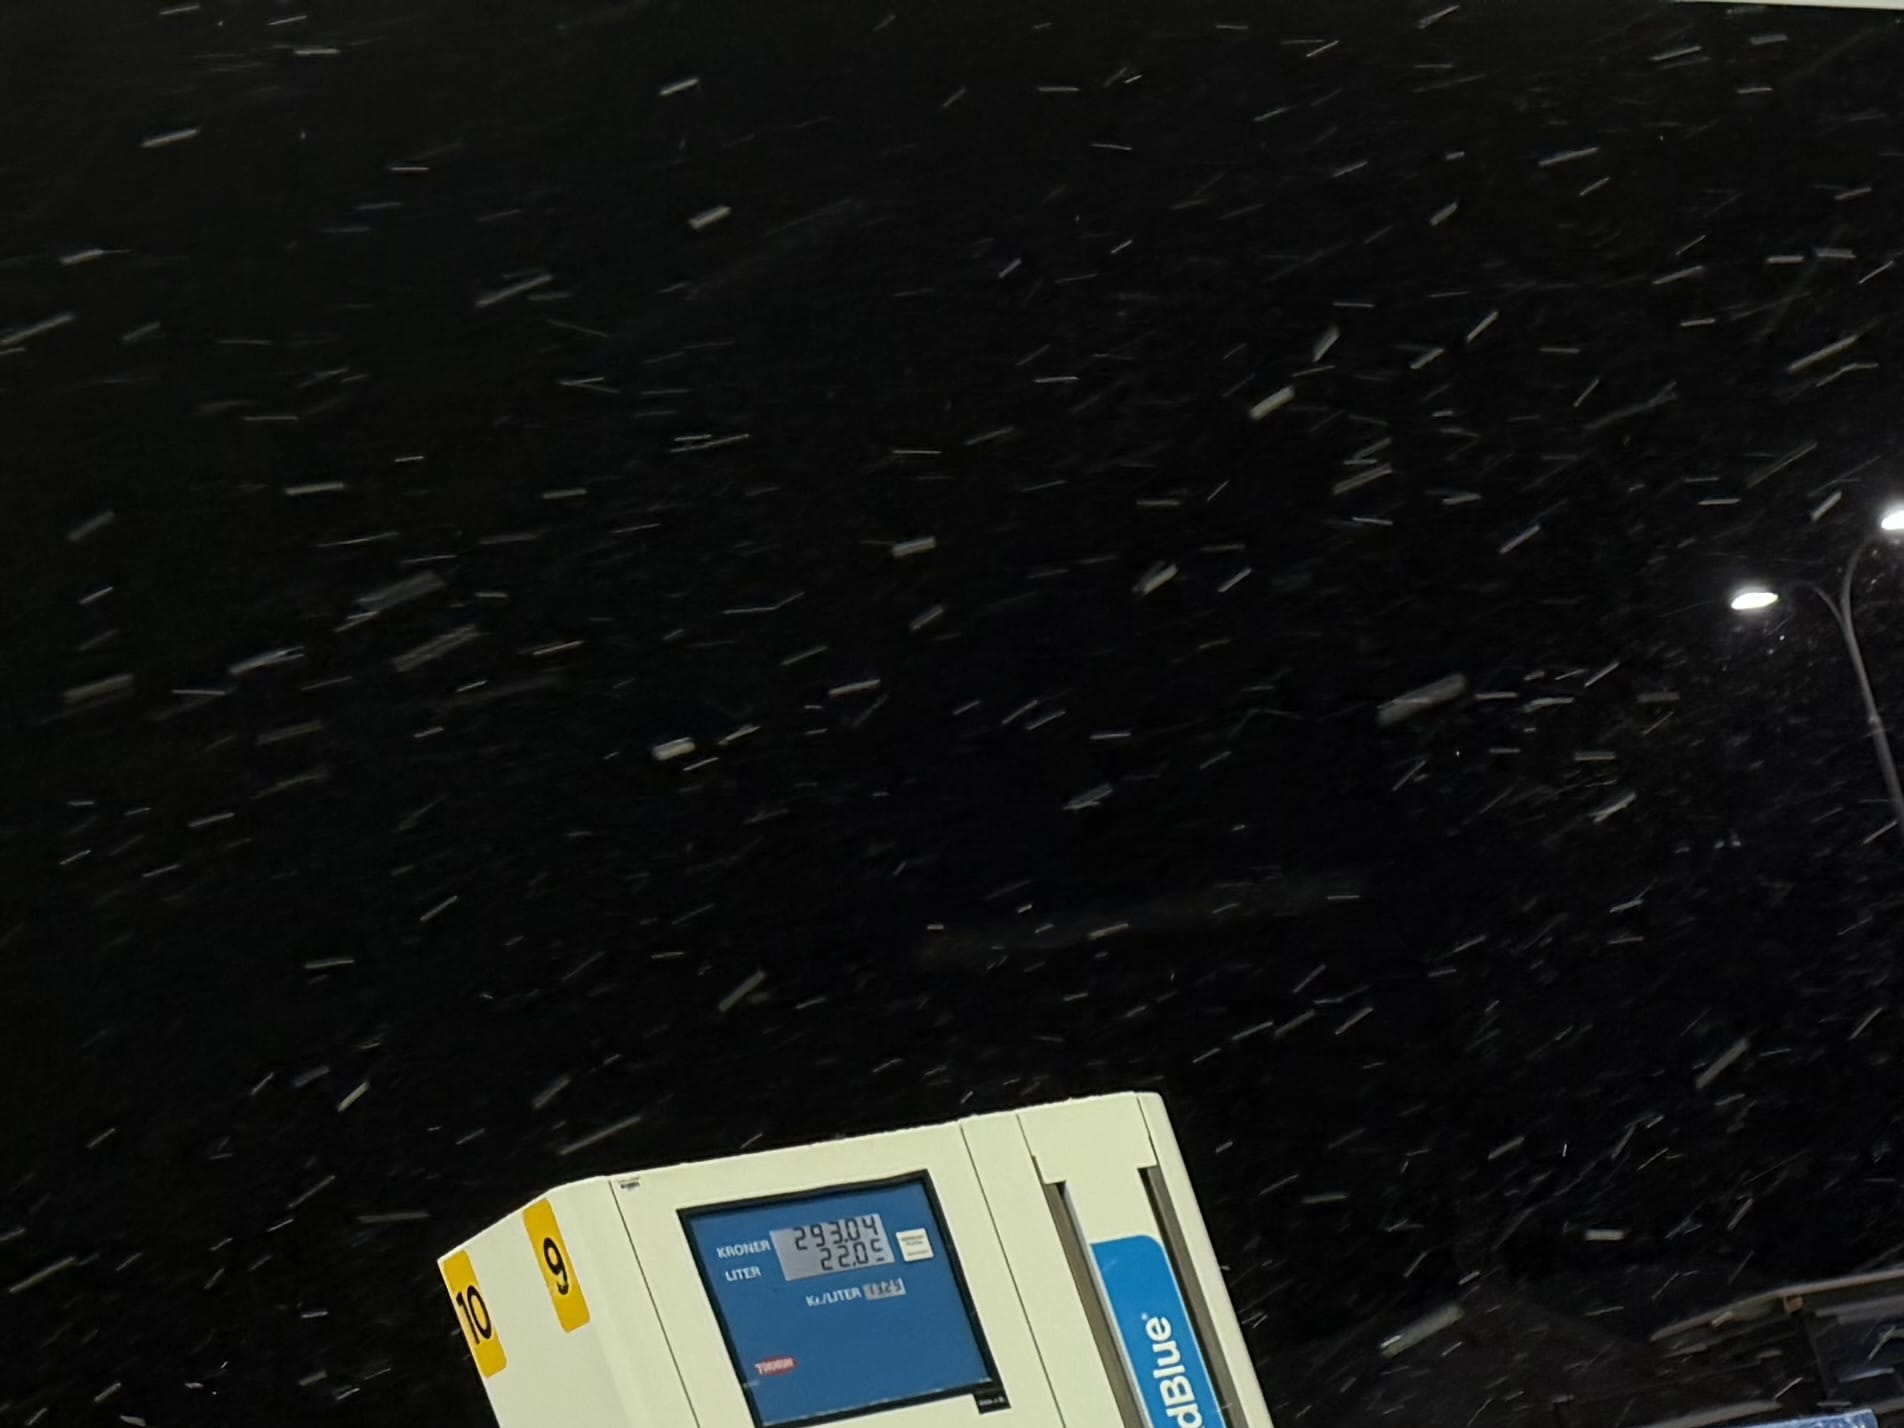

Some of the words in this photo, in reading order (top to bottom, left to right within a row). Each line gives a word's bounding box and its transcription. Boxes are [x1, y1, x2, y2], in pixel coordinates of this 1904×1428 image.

[543, 1237, 569, 1295] 9
[716, 1239, 771, 1259] KRONER
[725, 1266, 762, 1282] LITER
[456, 1285, 492, 1344] 10
